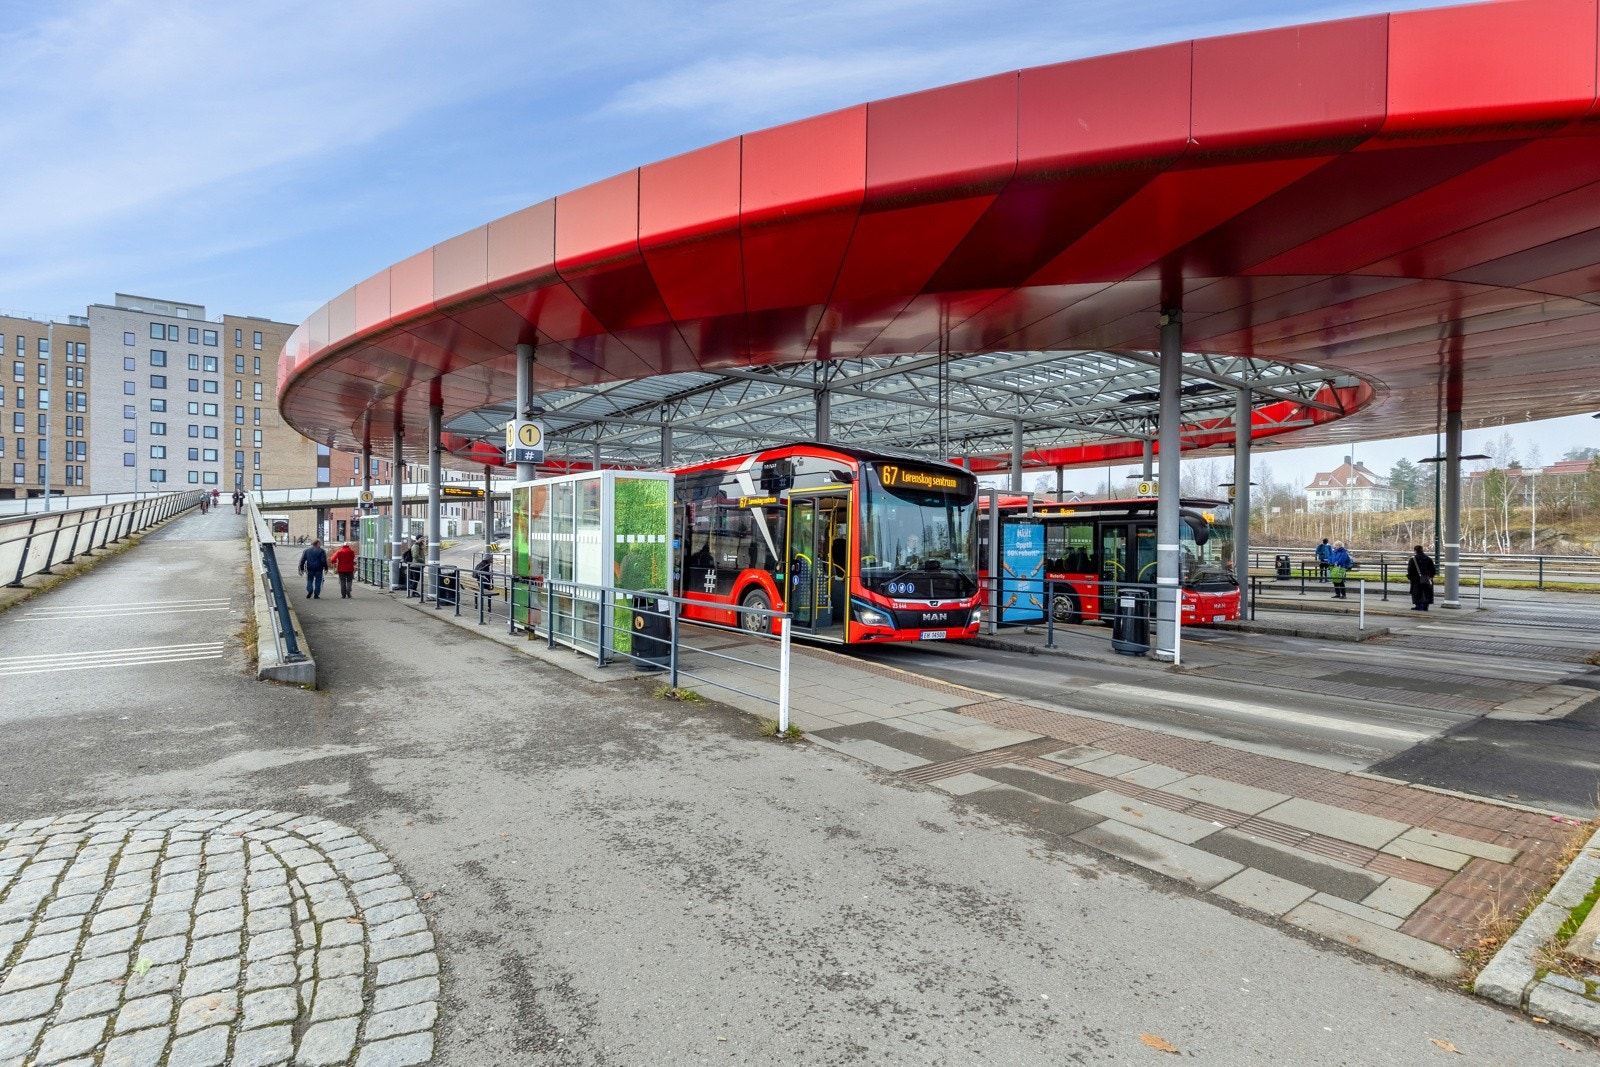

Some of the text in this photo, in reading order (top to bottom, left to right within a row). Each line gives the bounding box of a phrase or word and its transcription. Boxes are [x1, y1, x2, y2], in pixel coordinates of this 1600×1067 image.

[526, 428, 532, 442] 1
[882, 465, 957, 488] 67 Lørenskog sentrum
[1141, 484, 1147, 492] 3
[922, 613, 947, 621] MAN
